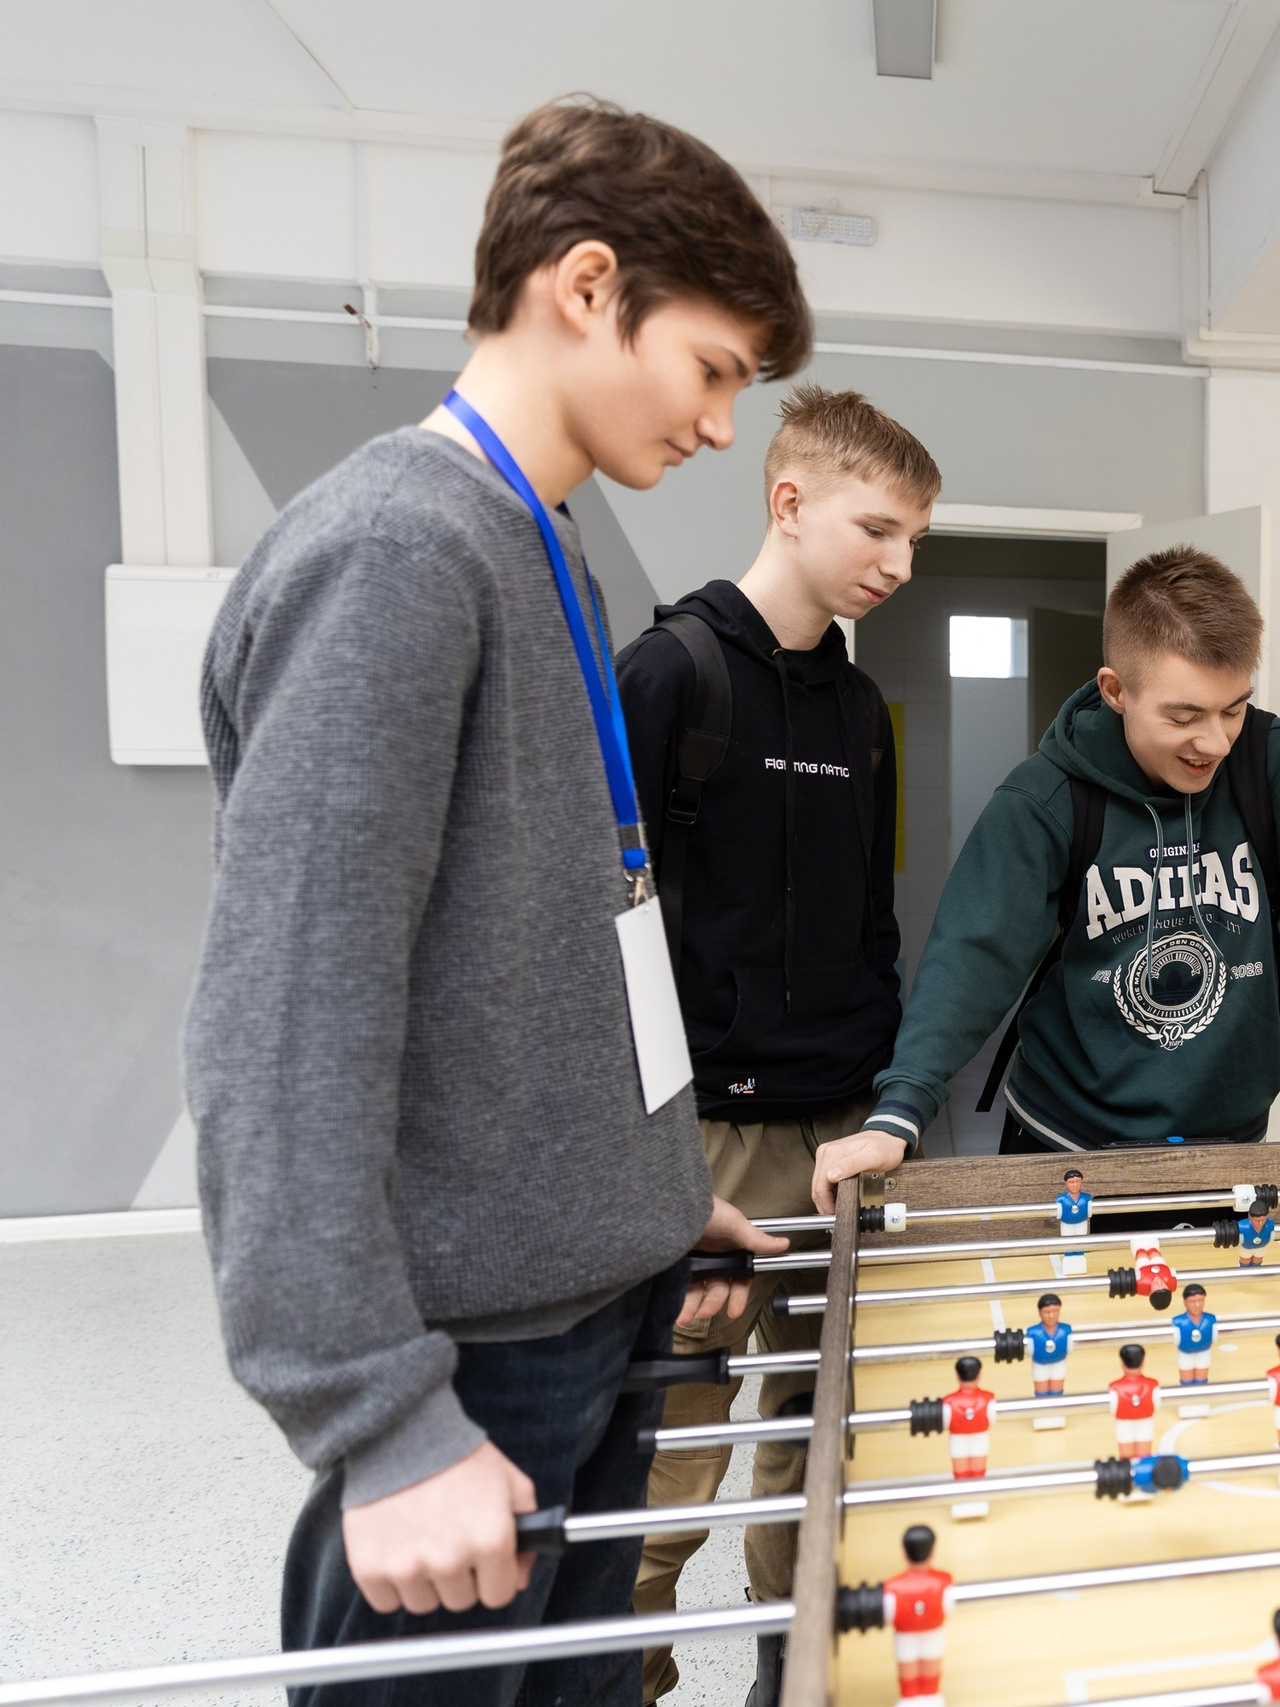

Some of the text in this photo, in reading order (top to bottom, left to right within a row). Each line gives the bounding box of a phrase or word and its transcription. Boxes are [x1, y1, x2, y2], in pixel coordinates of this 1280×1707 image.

[764, 758, 818, 774] FIGTING
[1150, 842, 1200, 859] OIGINLS
[1134, 956, 1149, 985] MARK
[1152, 945, 1168, 956] MIT
[1169, 939, 1188, 947] DEN
[1160, 1025, 1182, 1047] 50
